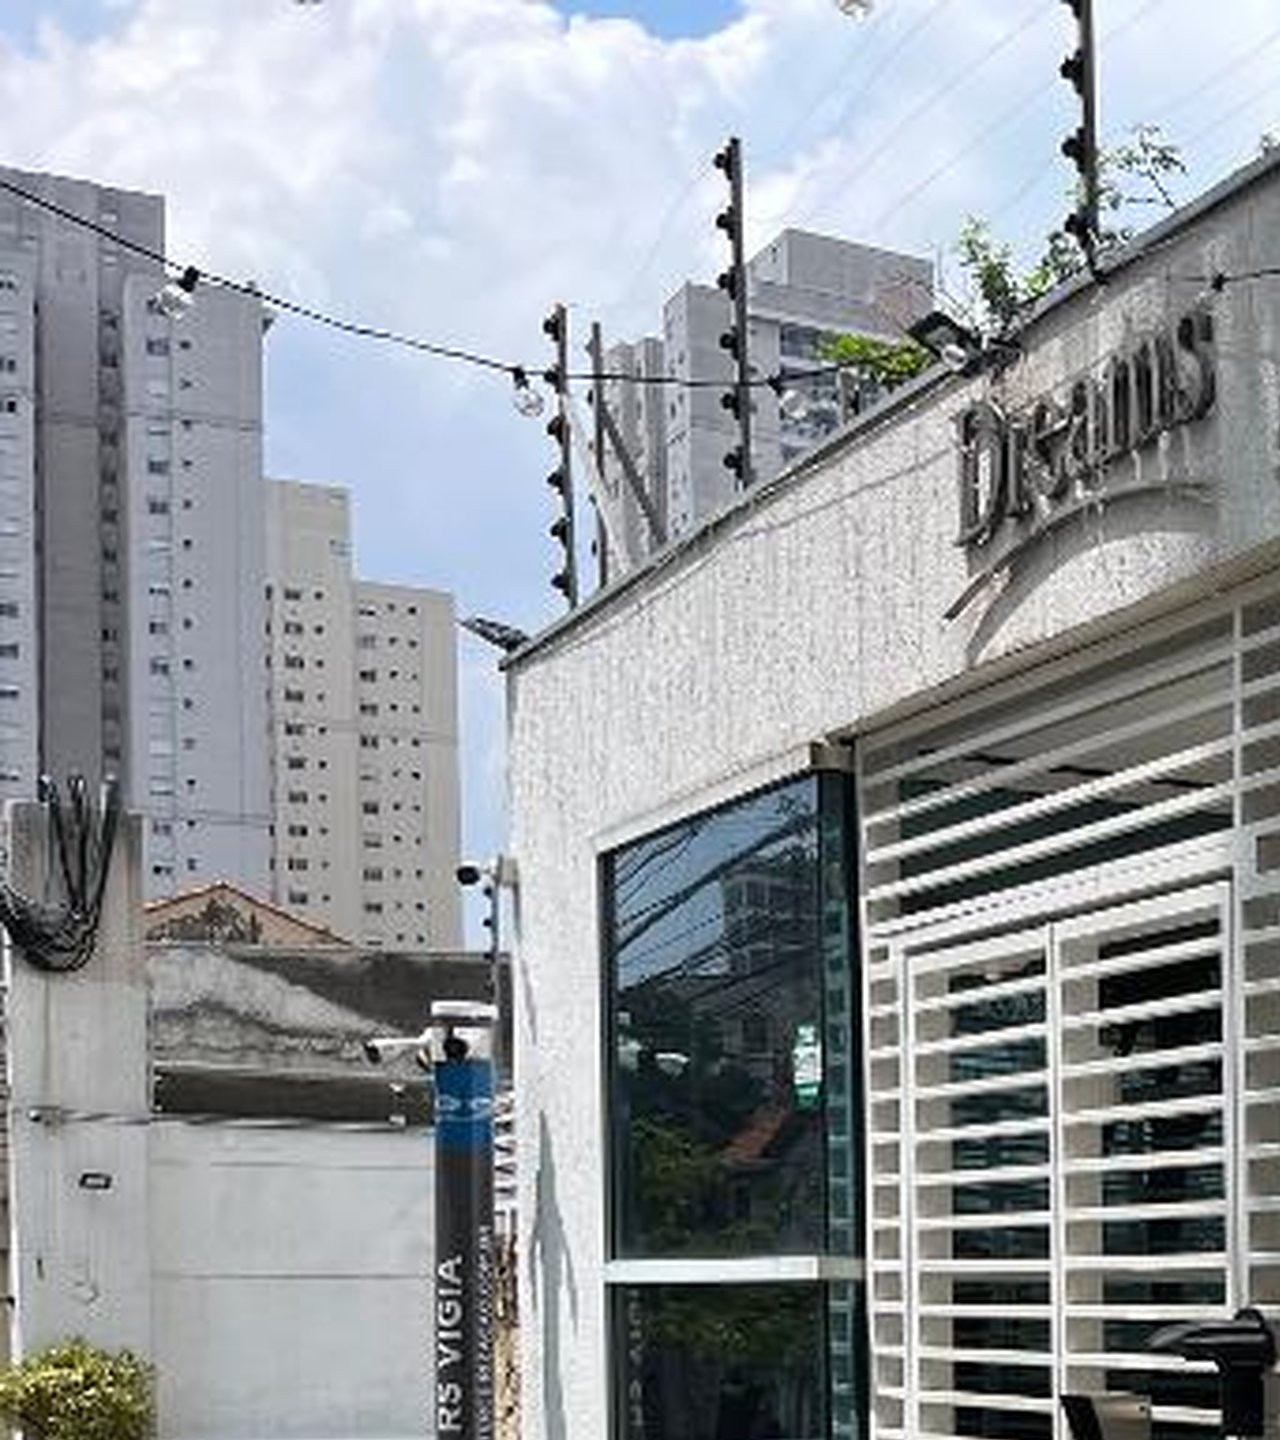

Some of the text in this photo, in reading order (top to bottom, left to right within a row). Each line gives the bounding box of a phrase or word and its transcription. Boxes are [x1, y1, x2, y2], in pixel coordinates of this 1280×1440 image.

[956, 314, 1216, 547] Dreams
[437, 1255, 462, 1432] RS VIGIA
